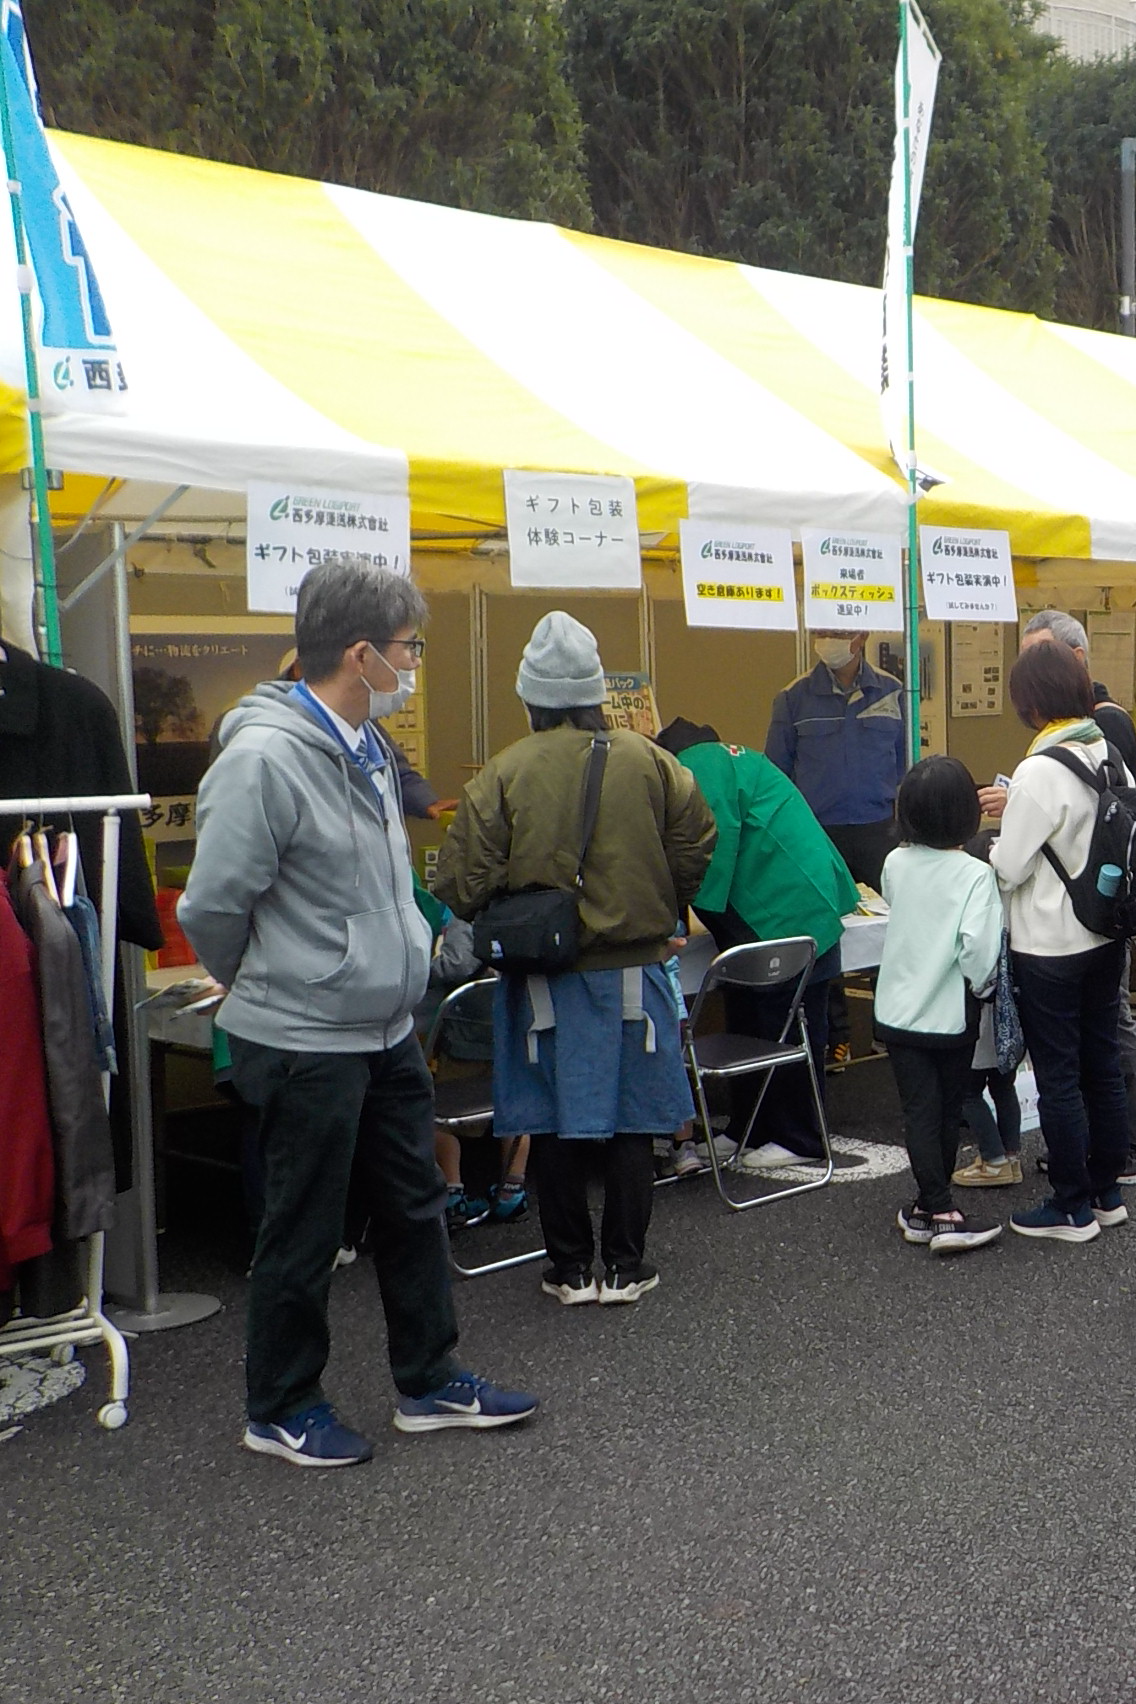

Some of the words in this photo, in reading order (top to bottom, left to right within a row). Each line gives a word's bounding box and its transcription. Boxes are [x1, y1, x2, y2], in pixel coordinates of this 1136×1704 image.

[526, 494, 623, 517] ギフト包装
[527, 527, 624, 547] 体験コーナー
[840, 568, 865, 580] 来場者
[811, 584, 894, 600] ボックスティッシュ
